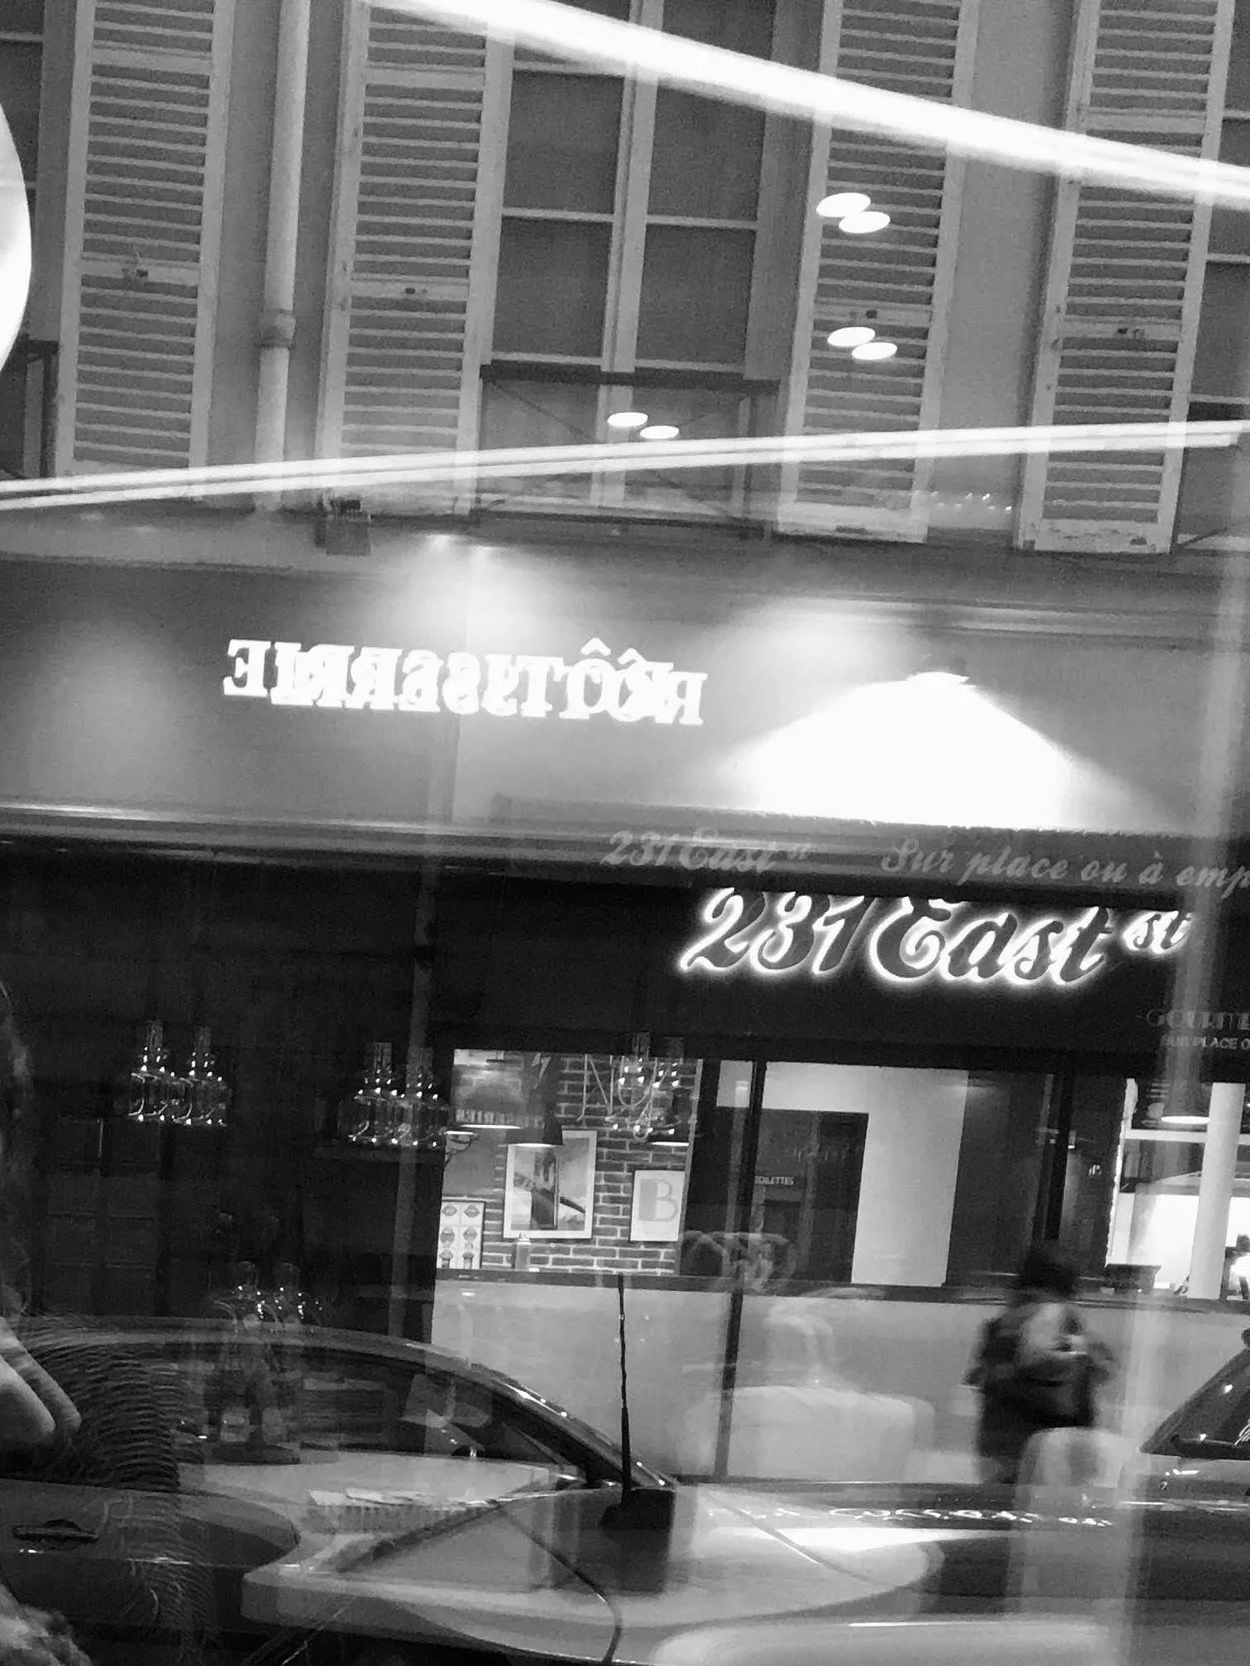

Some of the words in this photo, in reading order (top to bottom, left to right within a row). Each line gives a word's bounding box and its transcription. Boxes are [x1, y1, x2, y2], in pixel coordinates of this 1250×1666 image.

[881, 838, 955, 873] Sur
[957, 847, 1070, 886] place
[1081, 860, 1129, 883] ou
[872, 895, 1113, 984] East
